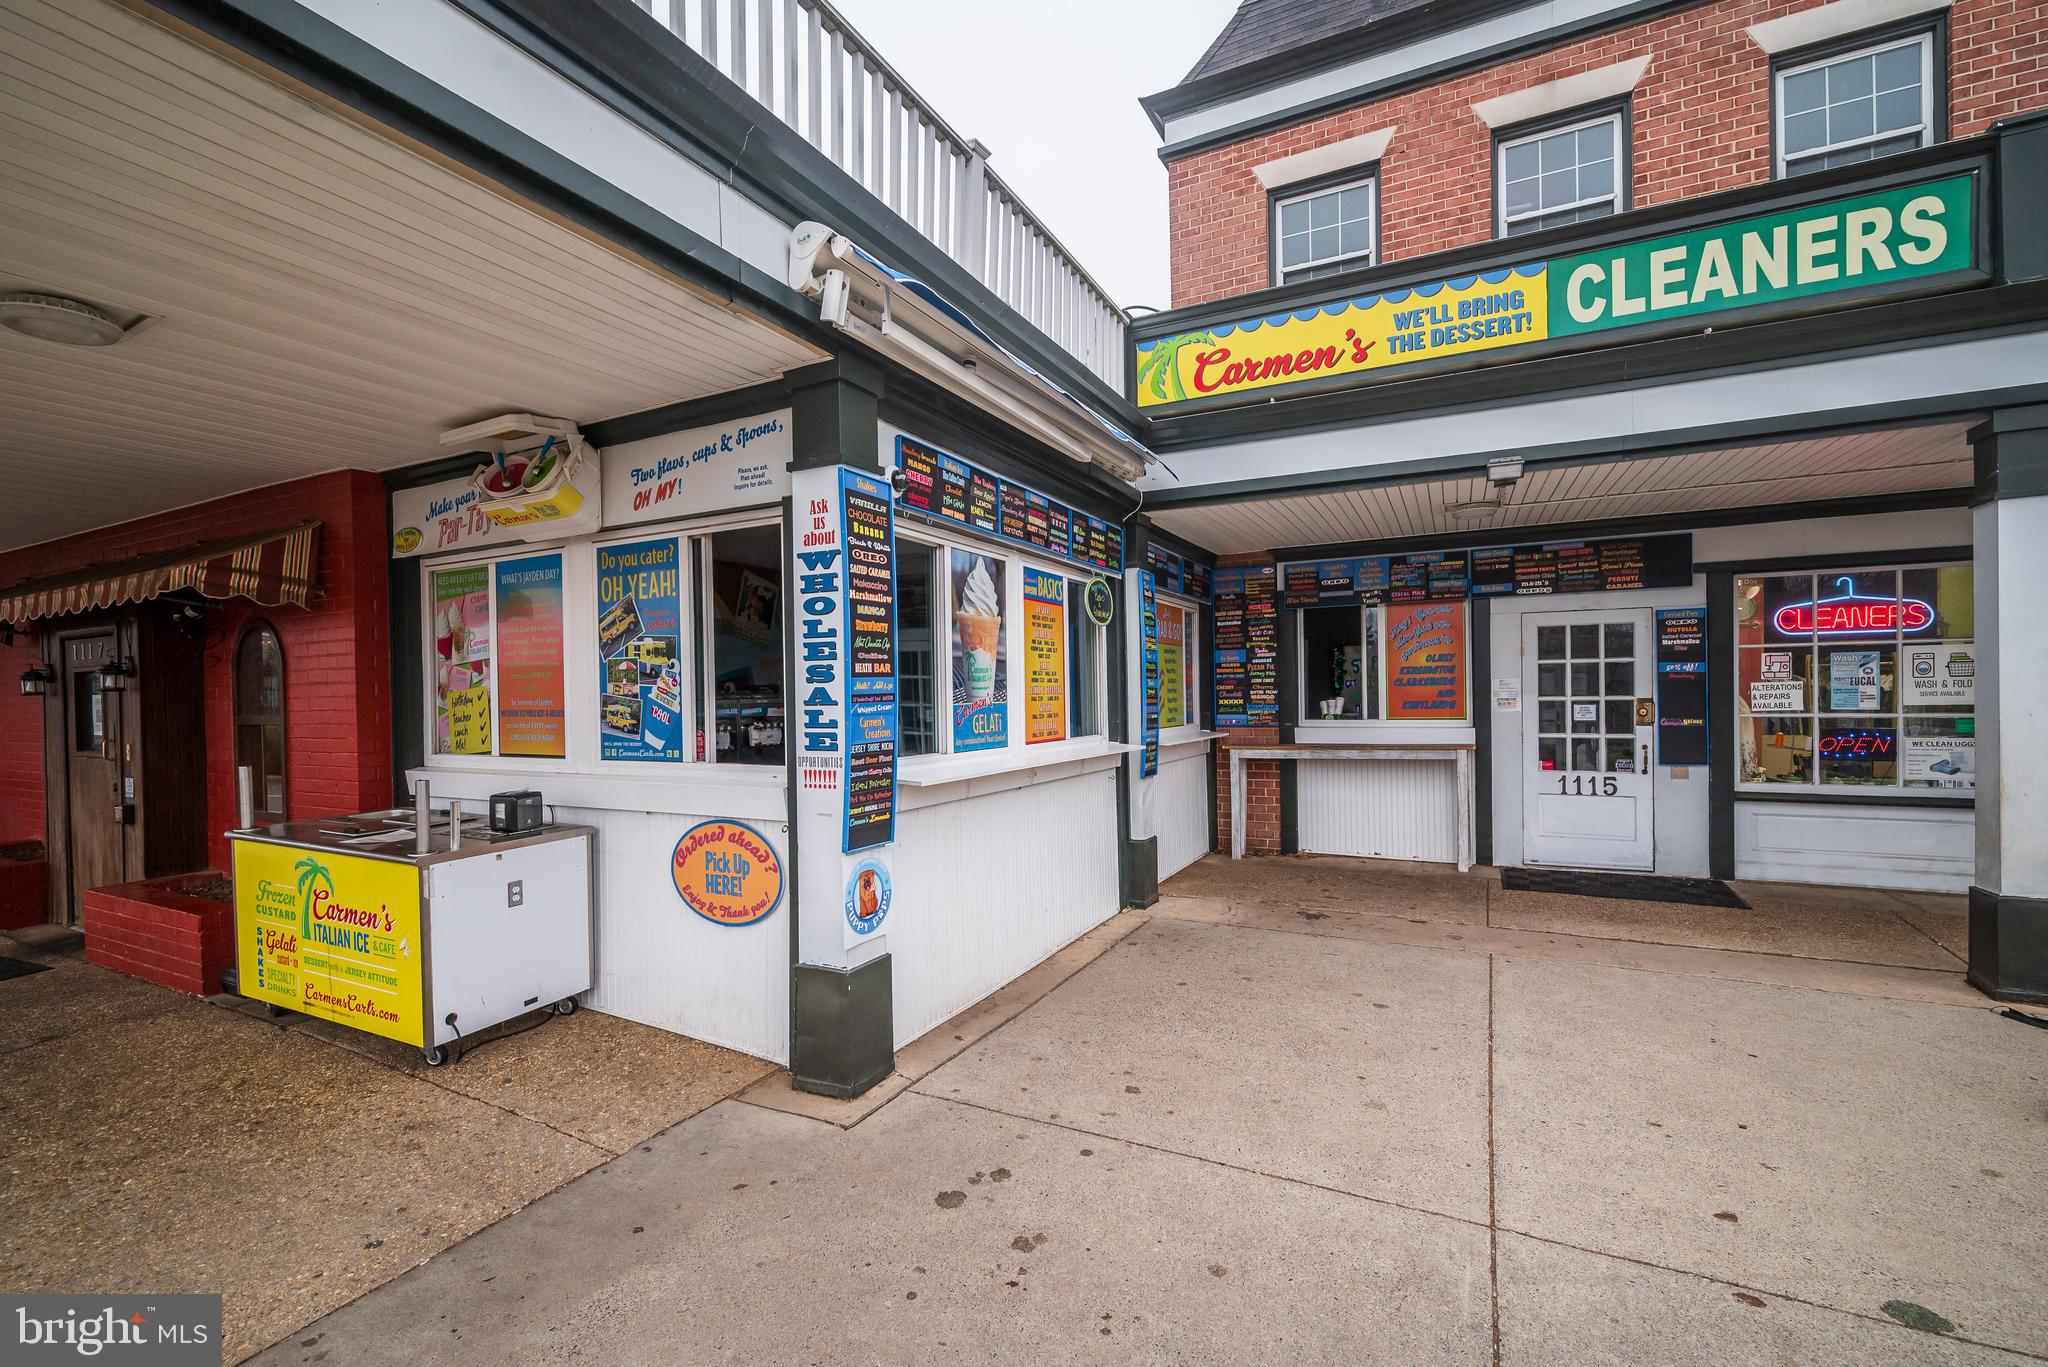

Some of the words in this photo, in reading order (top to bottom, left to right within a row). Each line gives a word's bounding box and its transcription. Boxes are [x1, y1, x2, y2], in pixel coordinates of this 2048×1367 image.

[1565, 194, 1948, 325] CLEANERS
[1393, 302, 1454, 332] WE'LL
[1457, 290, 1526, 319] BRING
[1386, 333, 1427, 354] THE
[1430, 313, 1532, 349] DESSERT!
[1193, 328, 1376, 394] Carmen's
[631, 468, 656, 486] Two
[692, 442, 717, 463] cups
[720, 433, 733, 452] &
[733, 481, 749, 490] Inquire
[749, 480, 757, 488] for
[740, 474, 750, 482] Plan
[856, 477, 877, 493] Shakes
[905, 468, 934, 487] CHERRY
[633, 488, 652, 511] OH
[654, 478, 682, 504] MY!
[426, 497, 453, 522] Make
[455, 490, 477, 512] your
[809, 499, 828, 515] Ask
[813, 516, 826, 530] us
[847, 508, 888, 527] CHOCOLATE
[803, 529, 836, 547] about
[853, 521, 885, 540] Banana
[602, 552, 616, 570] Do
[618, 552, 637, 573] you
[640, 544, 674, 565] cater?
[852, 548, 888, 565] OREO
[501, 572, 522, 585] WHAT'S
[522, 569, 545, 584] JAYDEN
[545, 568, 560, 580] DAY?
[849, 563, 868, 575] SALTED
[868, 566, 891, 579] CARAMEL
[601, 575, 623, 603] OH
[627, 568, 677, 600] YEAH!
[1038, 575, 1063, 601] BASICS
[849, 589, 893, 604] Marshmallow
[857, 604, 886, 617] MANGO
[1778, 603, 1926, 629] CLEANERS
[855, 619, 889, 634] Strawberry
[1665, 618, 1698, 626] OREO
[797, 549, 841, 751] WHOLESALE
[873, 663, 892, 673] BAR
[1751, 683, 1803, 692] ALTERATIONS
[1850, 676, 1877, 686] EUCAL
[1914, 680, 1938, 689] WASH
[1941, 680, 1949, 688] &
[1952, 679, 1973, 688] FOLD
[1752, 693, 1758, 701] &
[1759, 692, 1791, 701] REPAIRS
[1752, 702, 1793, 710] AVAILABLE
[857, 705, 877, 714] Whipped
[956, 692, 994, 728] Carmen's
[860, 716, 886, 729] Carmen's
[864, 727, 891, 739] Creations
[851, 744, 866, 754] JERSEY
[1819, 736, 1891, 753] OPEN
[798, 756, 844, 768] OPPORTUNITIES
[851, 758, 865, 766] Root
[1557, 774, 1618, 796] 1115
[675, 825, 725, 868] Ordered
[705, 850, 731, 873] Pick
[733, 854, 751, 880] Up
[256, 880, 296, 907] Frozen
[705, 873, 743, 897] HERE!
[312, 888, 396, 933] Carmen's
[682, 884, 706, 911] Enjoy
[707, 902, 718, 917] &
[720, 905, 750, 919] Thank
[751, 891, 771, 917] you!
[256, 906, 297, 921] CUSTARD
[846, 901, 870, 932] PUPPY
[266, 929, 298, 955] Gelati
[313, 923, 351, 950] ITALIAN
[353, 931, 370, 954] ICE
[256, 927, 265, 988] SHAKES
[378, 942, 396, 955] CAFE
[267, 967, 296, 986] SPECIALTY
[303, 955, 329, 969] DESSERT
[344, 966, 367, 979] JERSEY
[367, 972, 398, 987] ATTITUDE
[267, 983, 297, 998] DRINKS
[304, 982, 401, 1024] CarmensCarts.com
